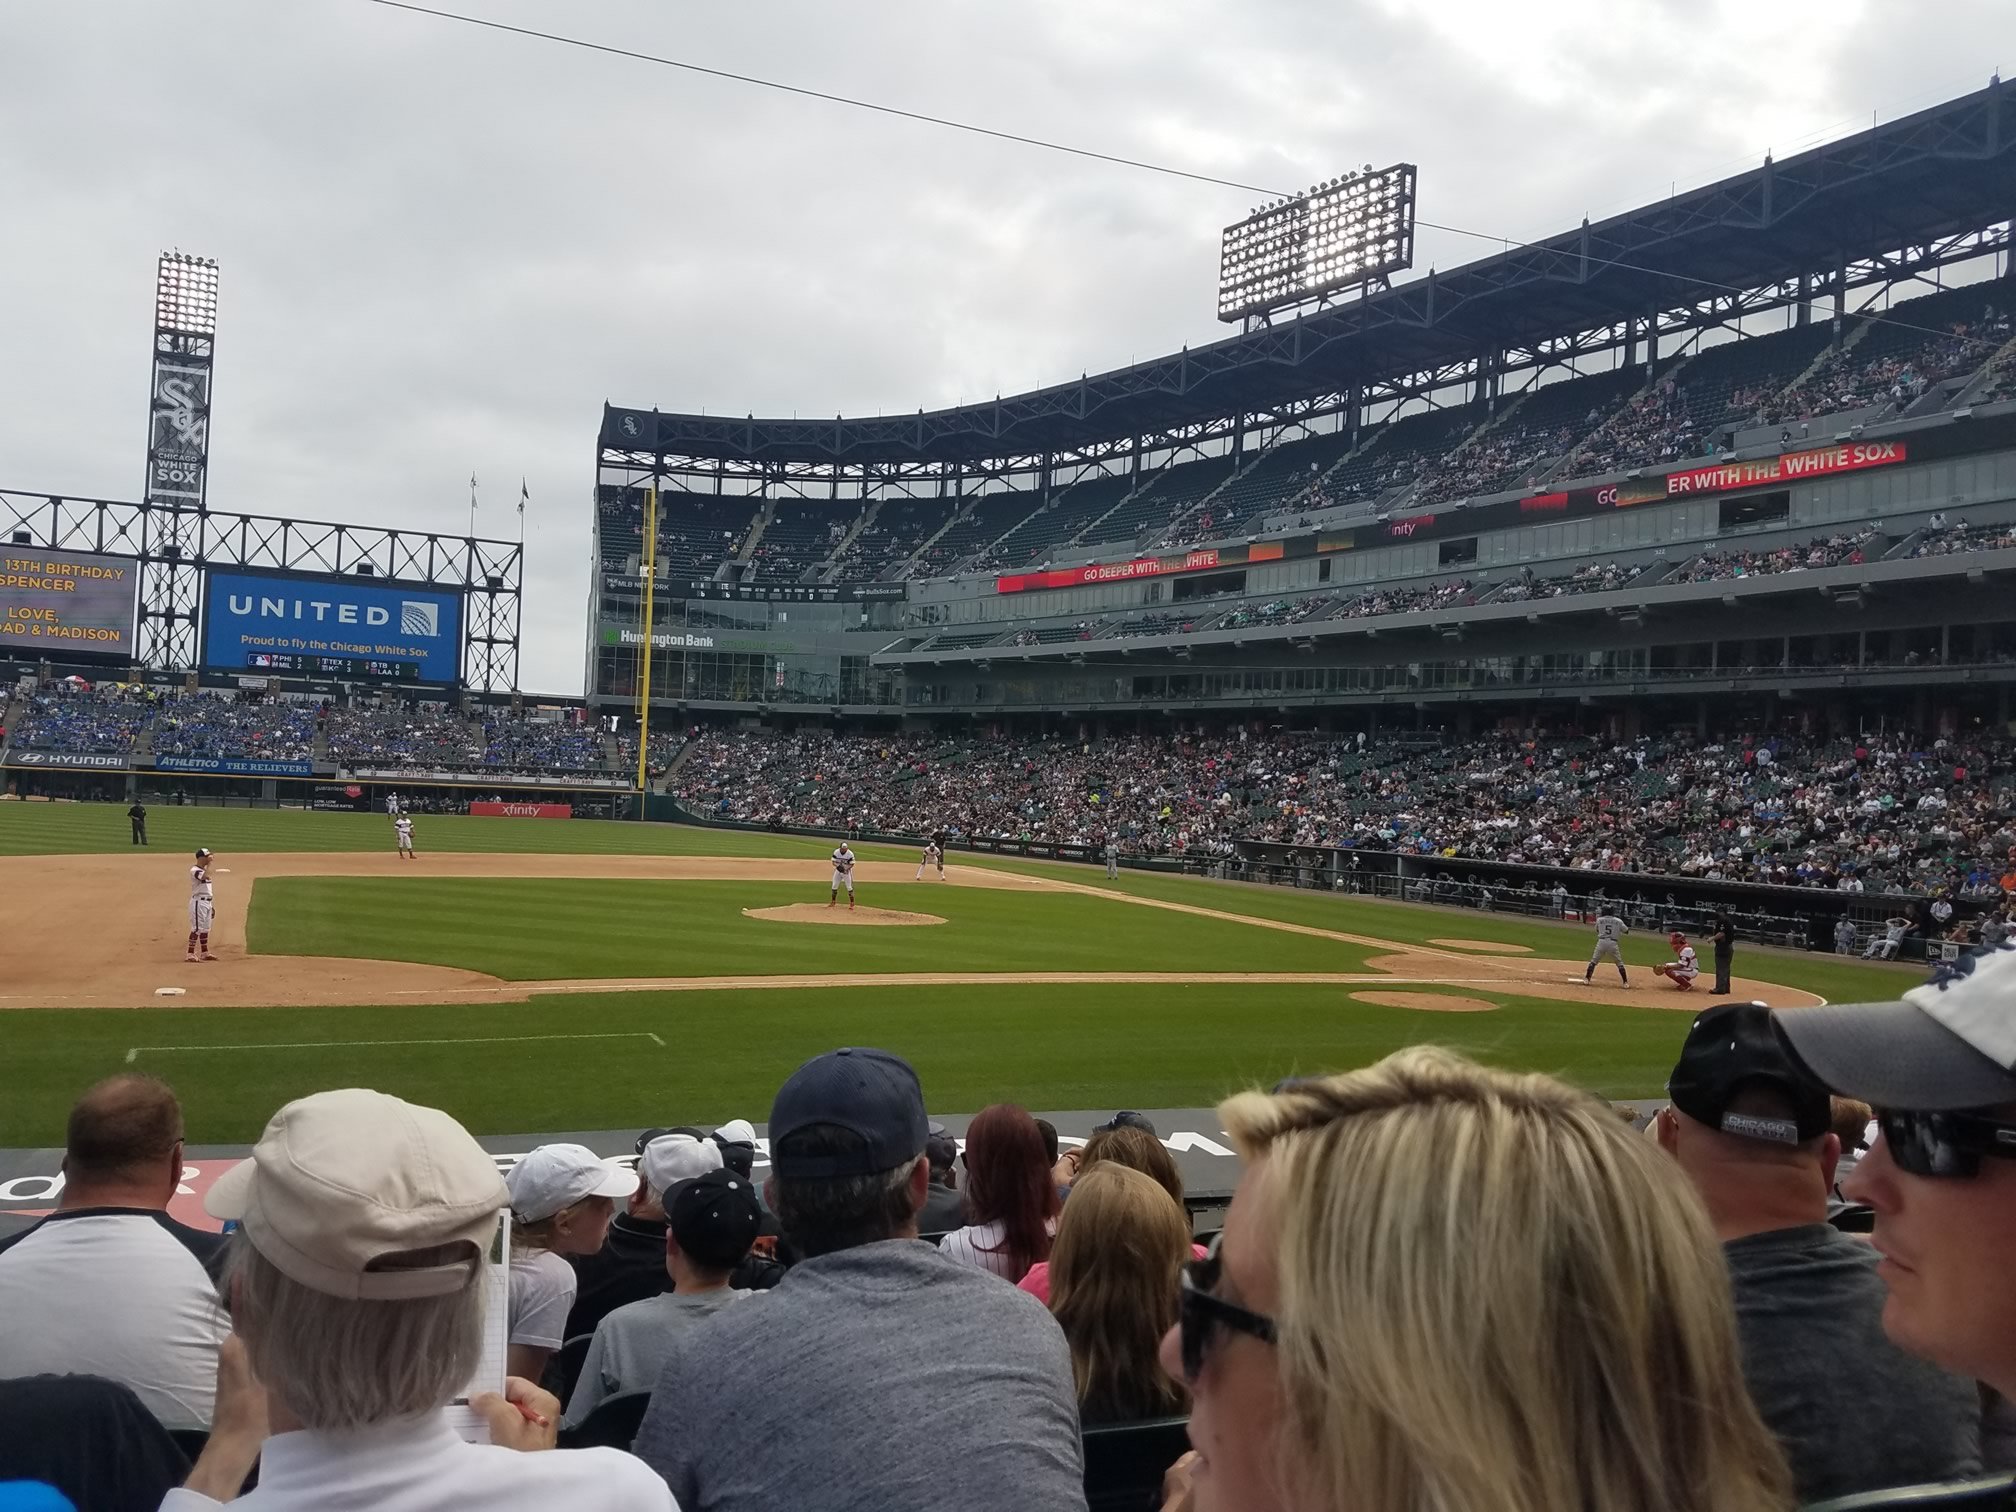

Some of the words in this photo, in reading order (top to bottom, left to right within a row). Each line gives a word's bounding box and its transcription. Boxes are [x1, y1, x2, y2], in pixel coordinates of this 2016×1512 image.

[158, 452, 198, 462] CHICAGO
[158, 459, 197, 471] WHITE
[1694, 469, 1740, 489] WITH
[1745, 465, 1780, 481] THE
[1785, 449, 1849, 475] WHITE
[1853, 442, 1896, 464] SOX
[157, 468, 196, 484] SOX
[5, 559, 40, 573] 13TH
[46, 563, 124, 580] BIRTHDAY
[1084, 569, 1098, 580] GO
[1099, 564, 1134, 578] DEEPER
[1136, 561, 1160, 574] WITH
[8, 606, 60, 623] LOVE,
[229, 595, 389, 626] UNITED
[0, 622, 26, 634] AD
[31, 624, 41, 635] &
[47, 625, 120, 642] MADISON
[621, 630, 685, 647] Hunngton
[686, 633, 714, 647] Bank
[241, 634, 275, 646] Proud
[278, 637, 289, 647] to
[291, 638, 306, 650] fly
[309, 640, 328, 651] the
[330, 641, 372, 654] Chicago
[374, 644, 406, 656] White
[409, 647, 429, 657] Sox
[50, 755, 123, 767] HYUNDAI
[160, 756, 220, 768] ATHLETICO
[226, 762, 248, 771] THE
[251, 763, 308, 773] RELIEVERS
[502, 804, 541, 817] xfinity
[1605, 924, 1612, 935] 5
[1728, 1115, 1786, 1132] CHICAGO
